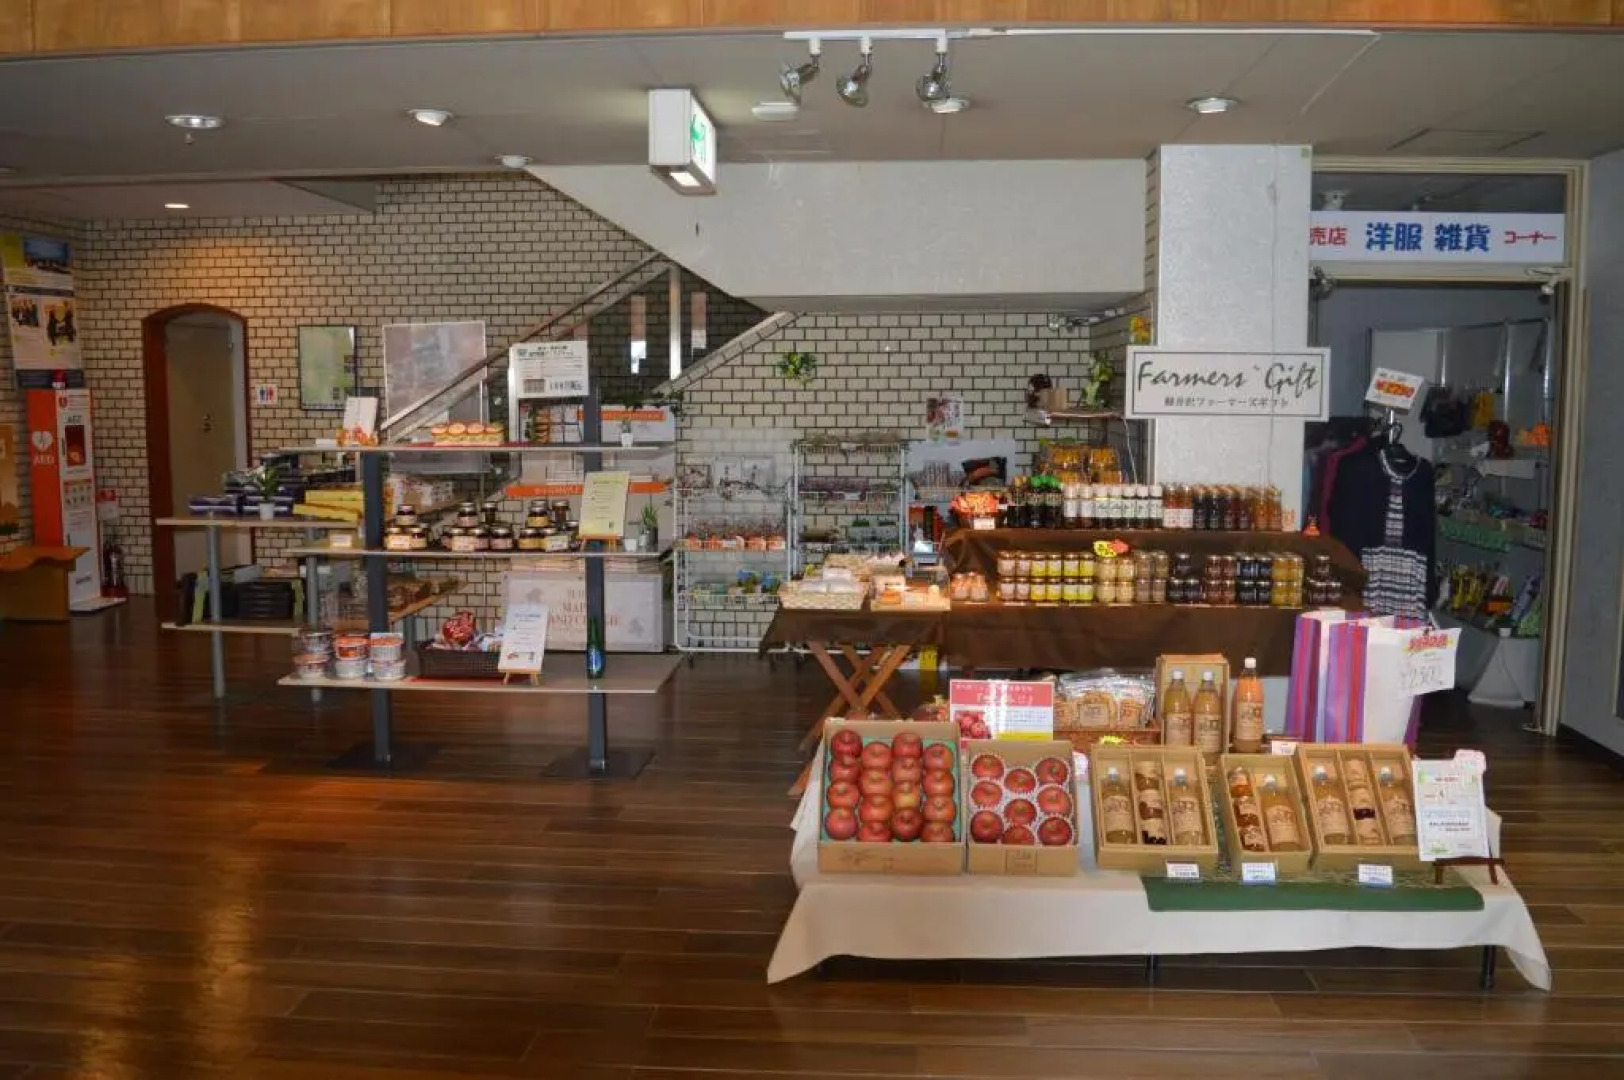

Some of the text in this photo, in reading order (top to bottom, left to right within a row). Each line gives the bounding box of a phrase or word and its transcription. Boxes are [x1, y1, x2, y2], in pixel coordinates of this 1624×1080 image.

[1309, 221, 1557, 253] 売店 洋服 雑貨 コーナー
[1264, 361, 1320, 398] Gift
[33, 455, 54, 464] AED
